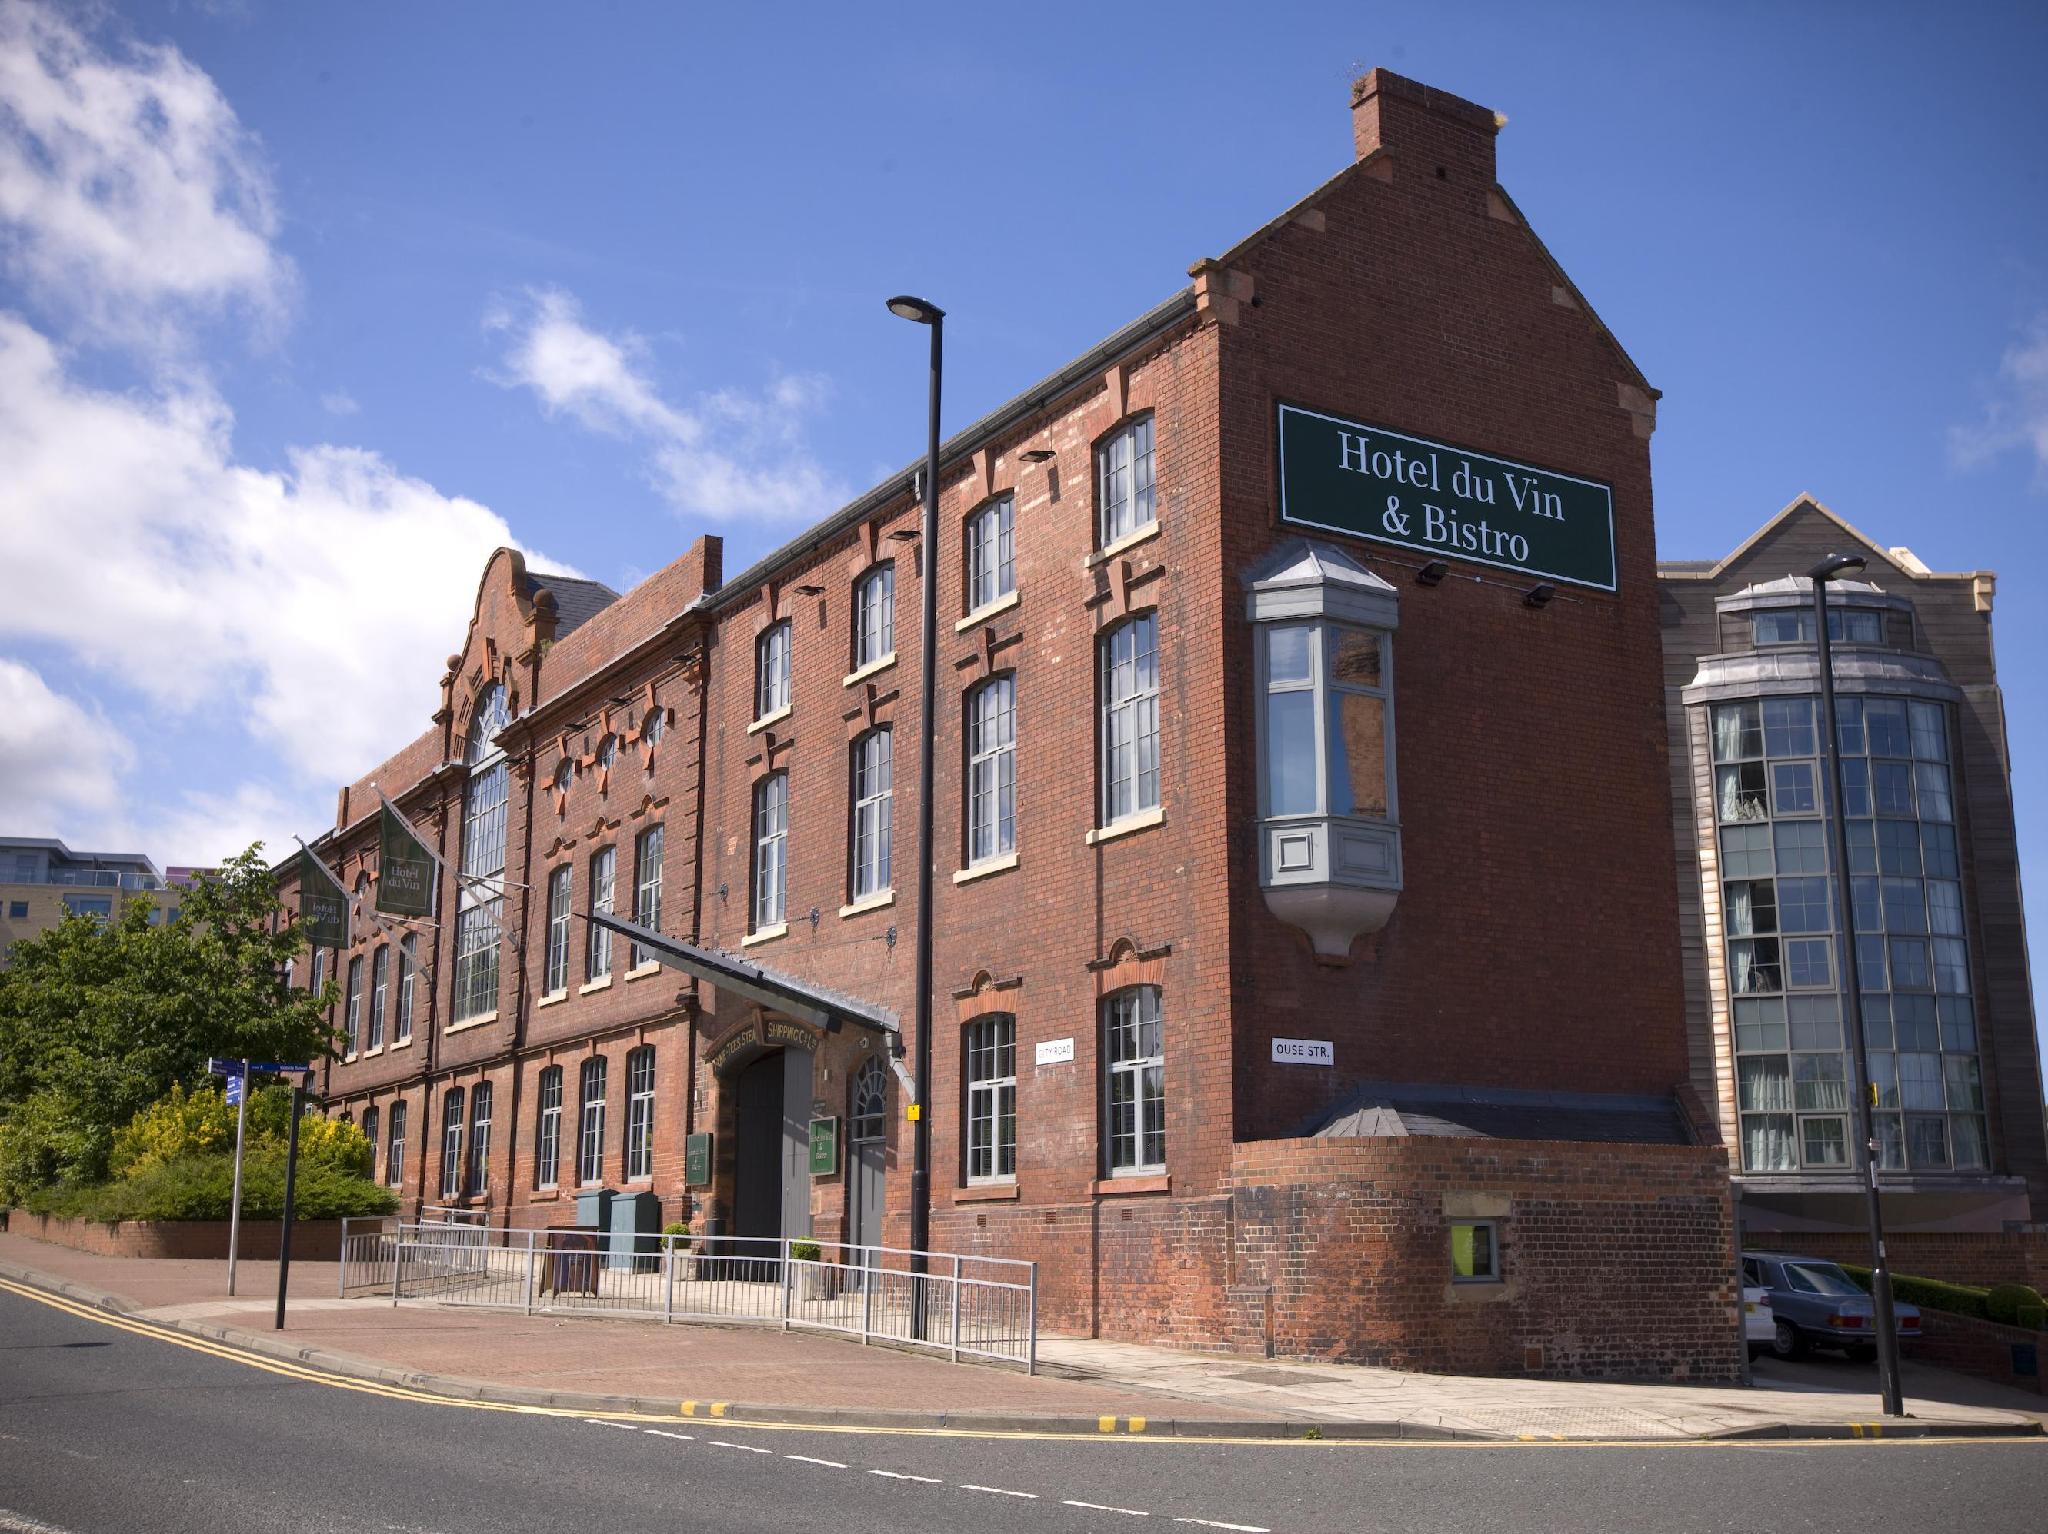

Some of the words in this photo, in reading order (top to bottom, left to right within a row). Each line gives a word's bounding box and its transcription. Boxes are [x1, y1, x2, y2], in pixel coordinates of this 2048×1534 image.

[1338, 431, 1440, 492] Hotel
[1452, 461, 1496, 505] du
[1503, 472, 1565, 521] Vin
[1382, 496, 1410, 536] &
[1422, 503, 1529, 562] Bistro
[391, 866, 418, 879] Hotel
[388, 877, 401, 888] du
[402, 878, 420, 890] Vin
[741, 1029, 756, 1046] STEA
[767, 1022, 799, 1041] SHIPPING
[1053, 1044, 1071, 1056] ROAD
[1276, 1044, 1304, 1056] OUSE
[1308, 1046, 1330, 1058] STR.
